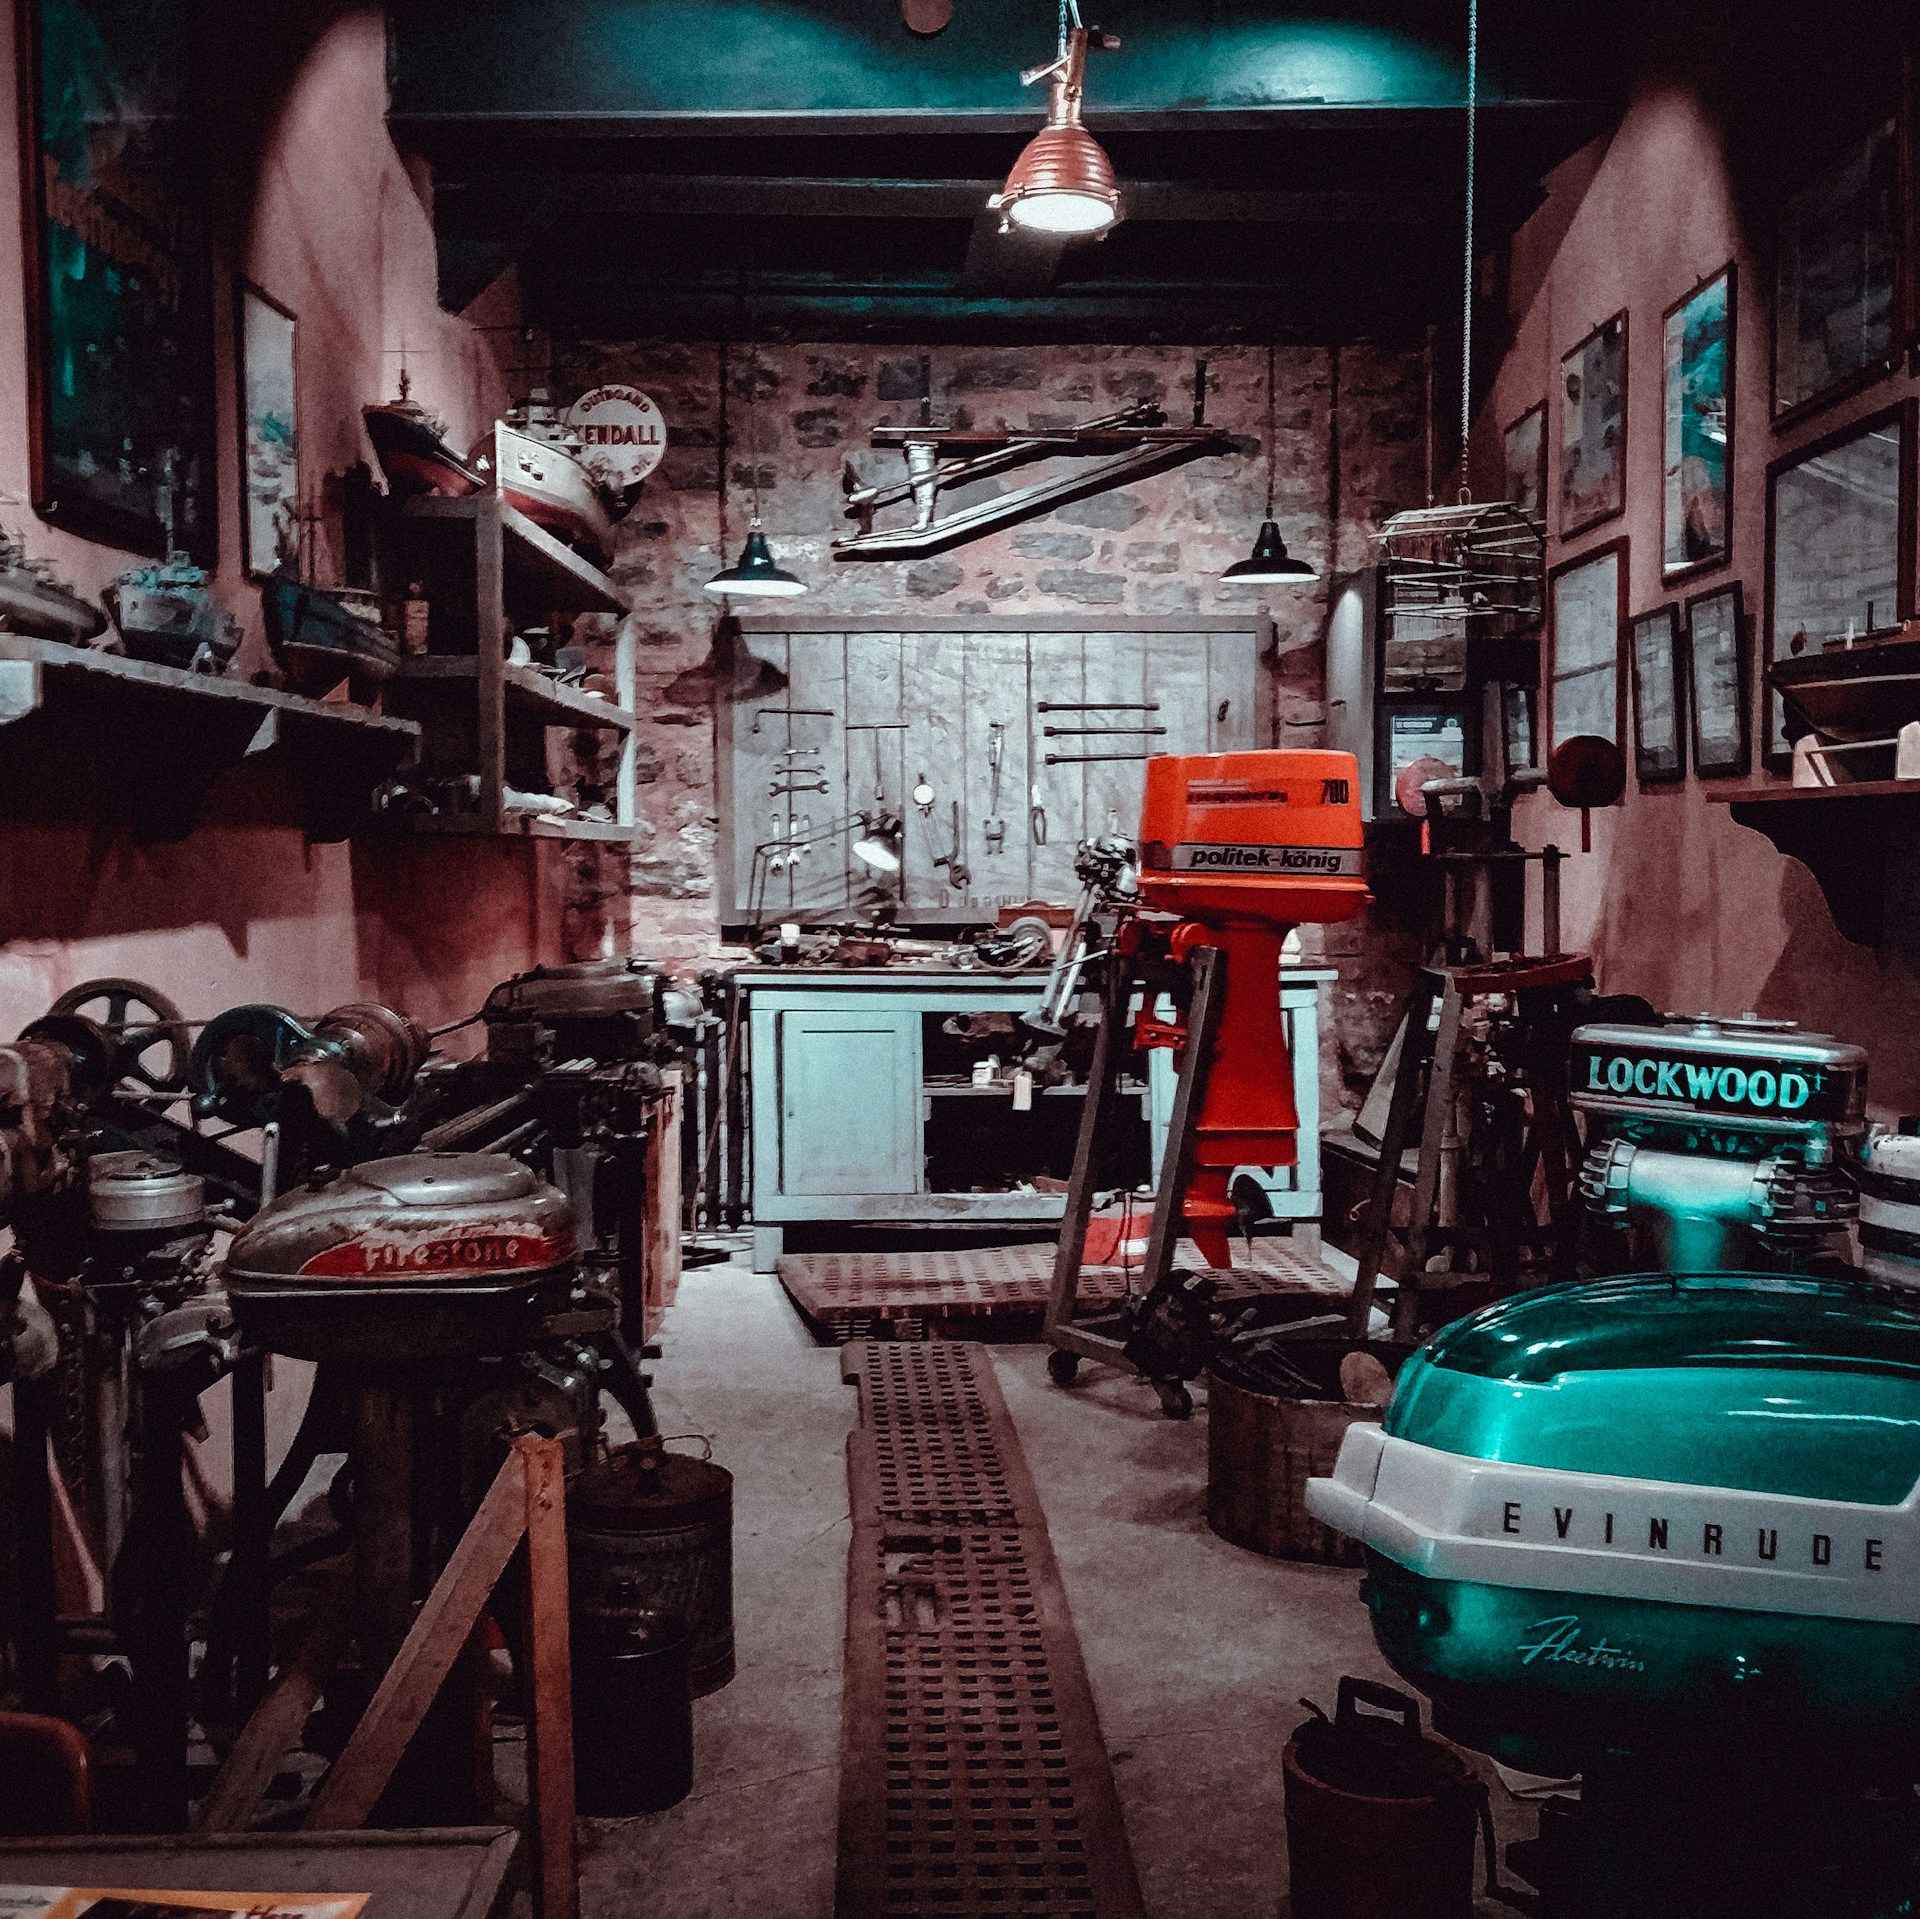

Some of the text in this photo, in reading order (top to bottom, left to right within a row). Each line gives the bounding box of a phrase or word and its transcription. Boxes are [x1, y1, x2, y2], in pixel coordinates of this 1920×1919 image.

[580, 389, 650, 413] OUTBOARD
[1190, 848, 1342, 872] politek-könig
[1586, 1055, 1810, 1110] LOCKWOOD
[362, 1238, 520, 1273] Firestone
[1502, 1501, 1884, 1572] EVINRUDE
[1516, 1614, 1645, 1672] Fleetwin
